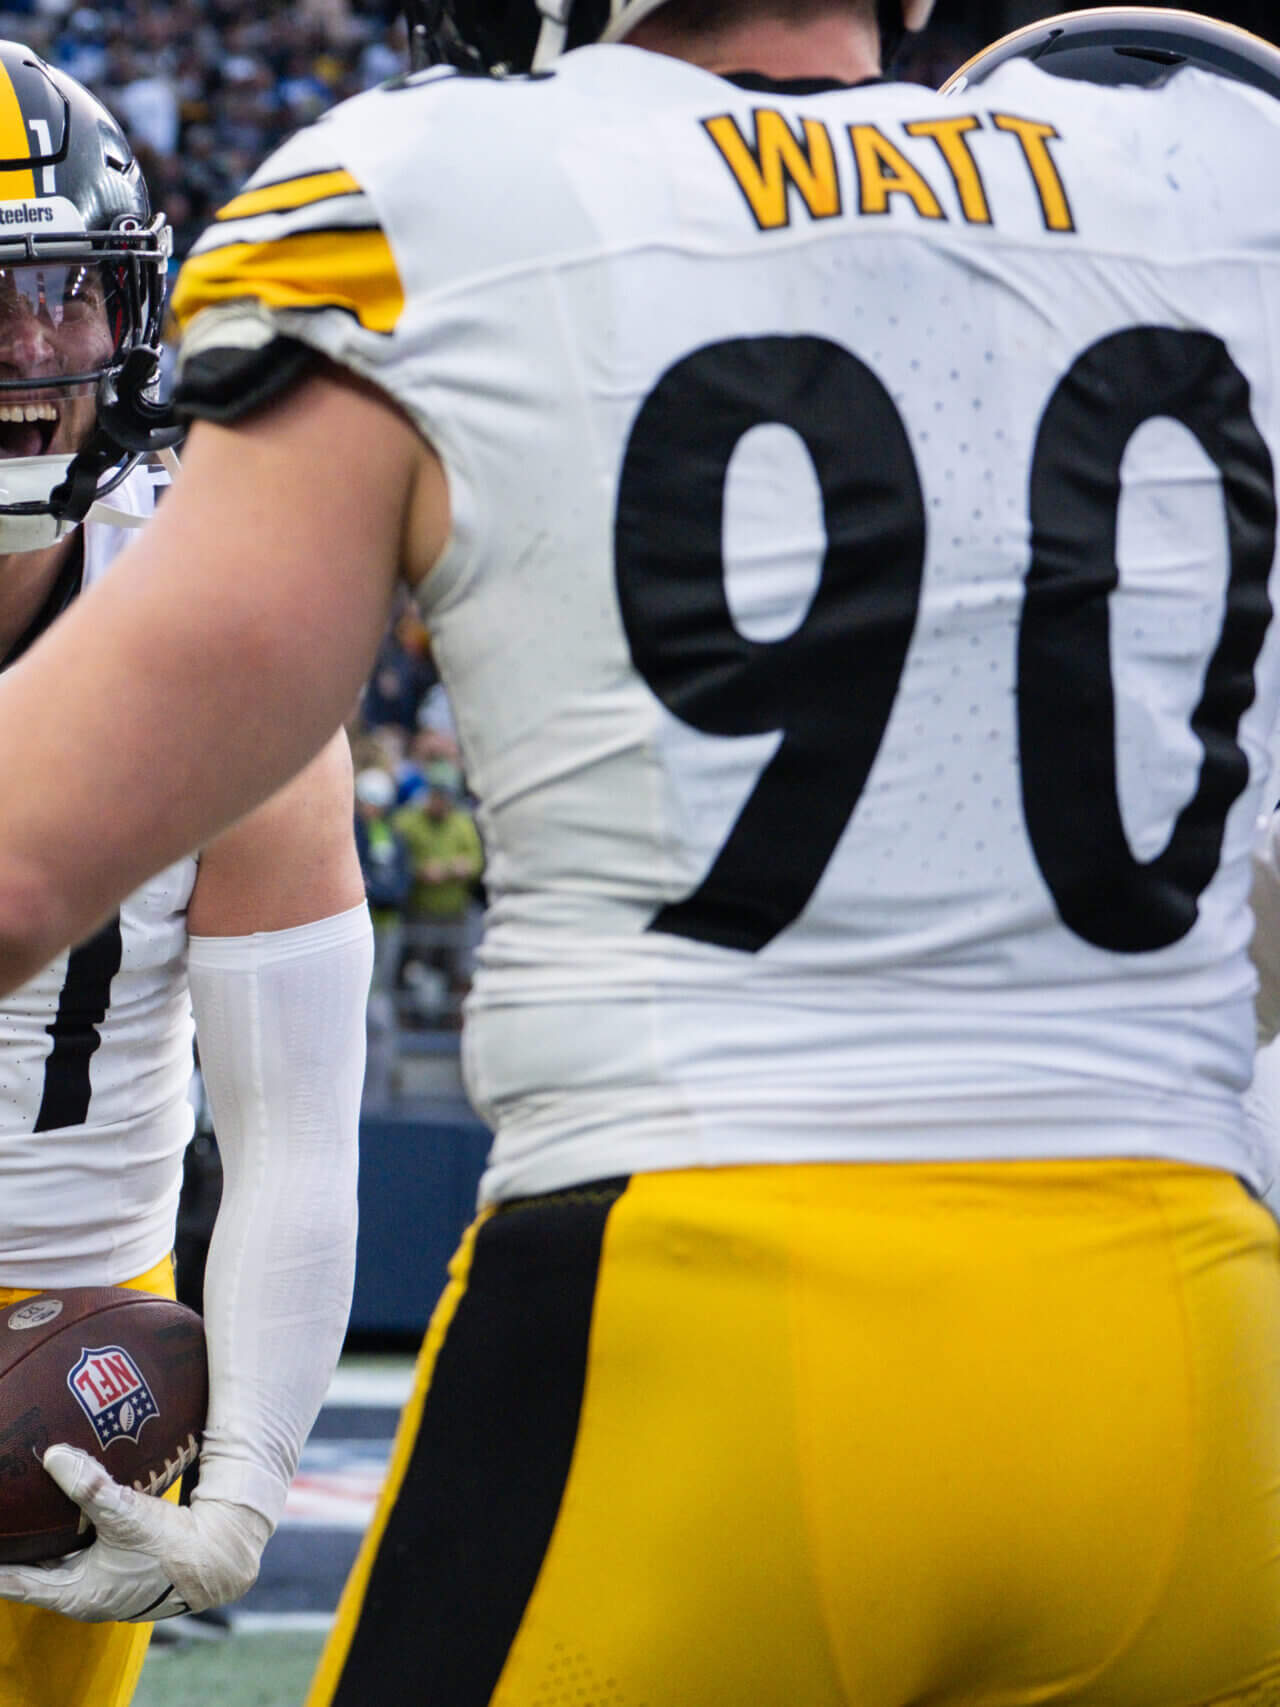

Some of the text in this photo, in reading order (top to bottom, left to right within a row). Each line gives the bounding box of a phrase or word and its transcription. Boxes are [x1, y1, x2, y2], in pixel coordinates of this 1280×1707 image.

[700, 106, 1078, 235] WATT
[613, 326, 1278, 955] 90
[76, 1354, 140, 1408] NFL
